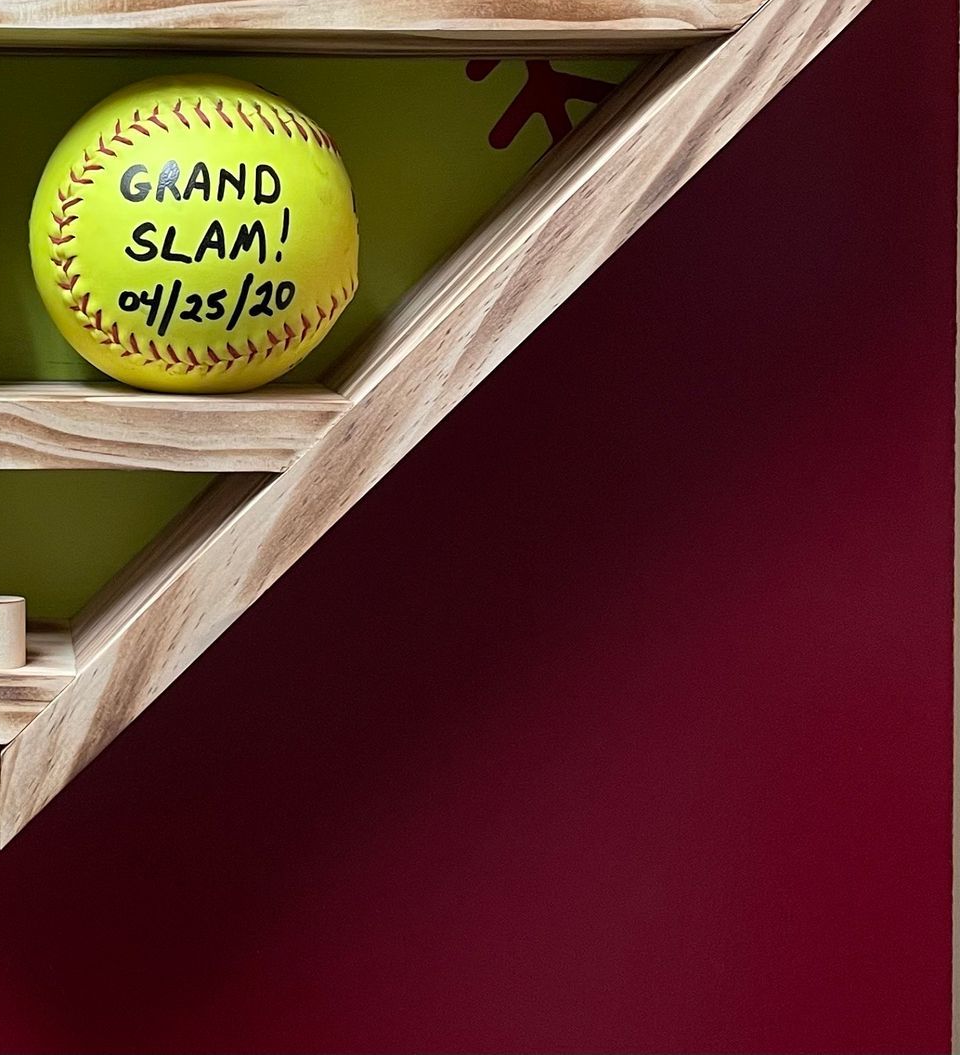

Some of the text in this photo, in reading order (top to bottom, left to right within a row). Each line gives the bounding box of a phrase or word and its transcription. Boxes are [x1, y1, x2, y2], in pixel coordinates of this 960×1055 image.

[119, 160, 281, 205] GRAND
[125, 207, 290, 264] SLAM!
[118, 272, 296, 336] 04/25/20
